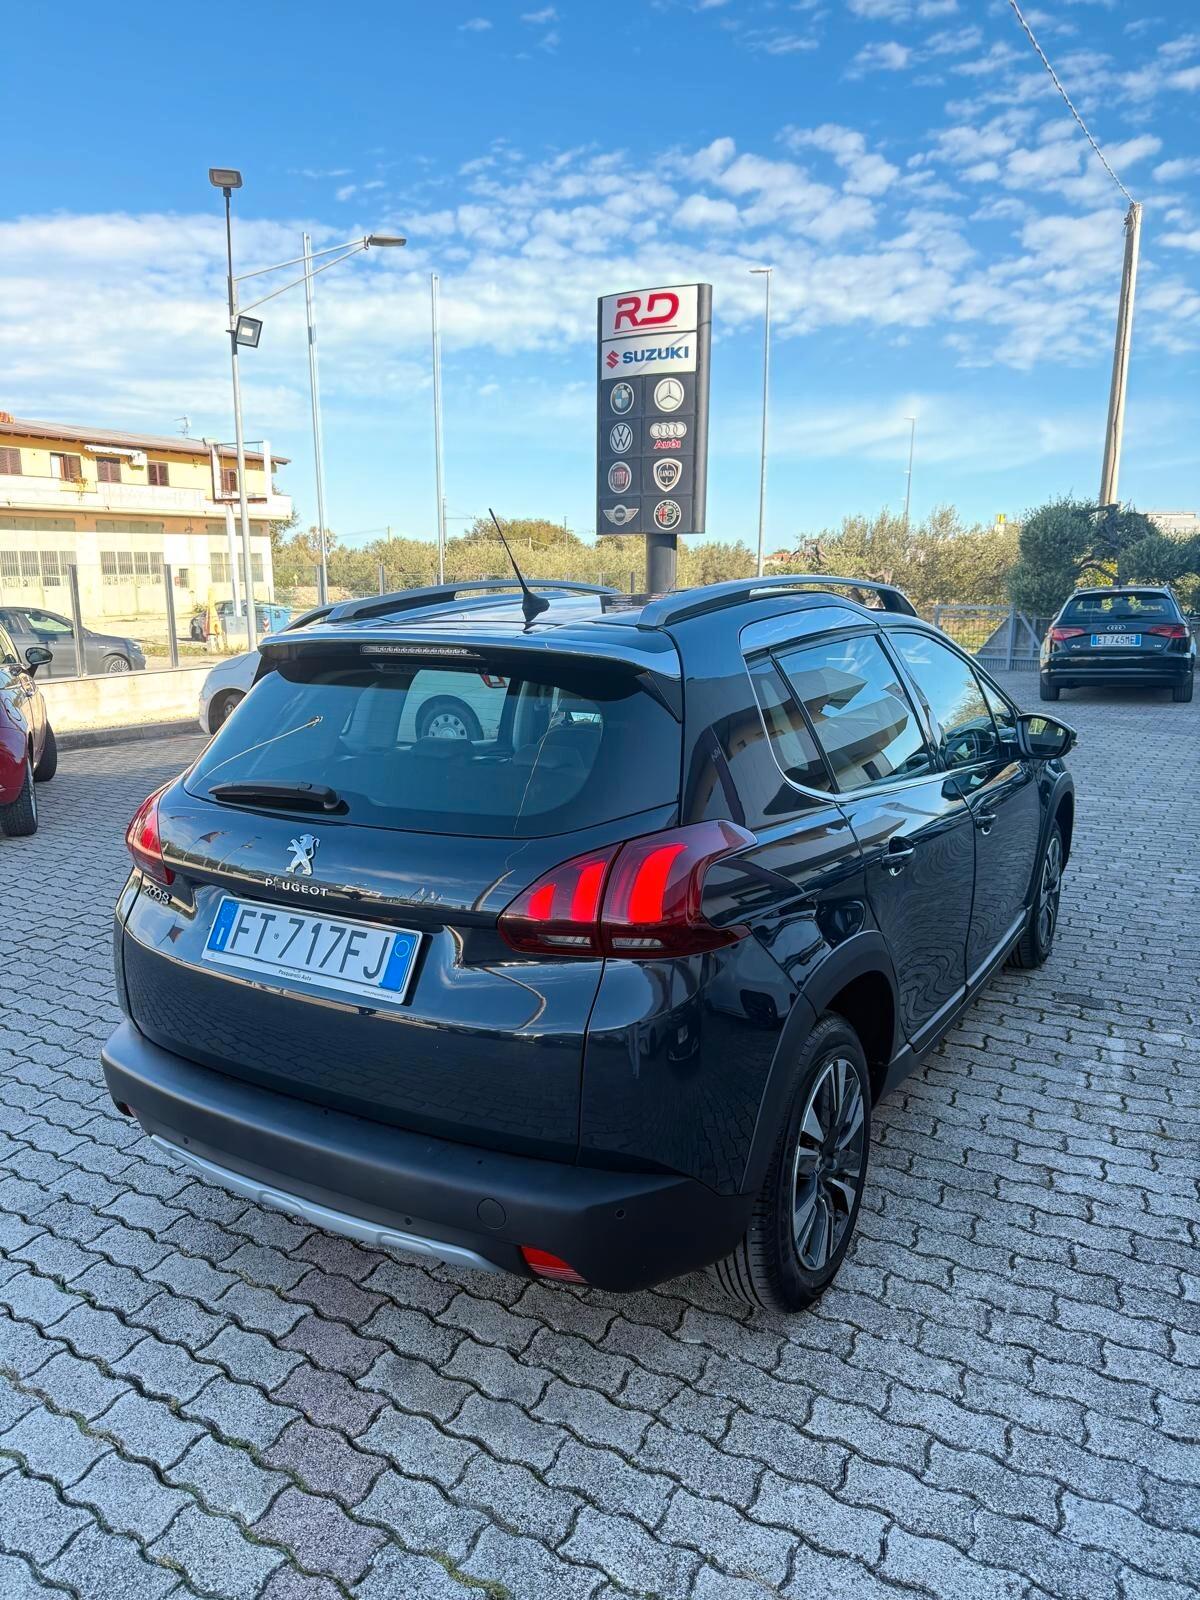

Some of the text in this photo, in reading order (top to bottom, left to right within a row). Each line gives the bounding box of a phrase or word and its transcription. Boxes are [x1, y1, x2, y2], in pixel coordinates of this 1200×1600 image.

[614, 292, 680, 330] RD
[622, 346, 690, 364] SUZUKI
[653, 439, 682, 450] Audi
[229, 909, 277, 955] FT
[277, 917, 390, 979] 717FJ
